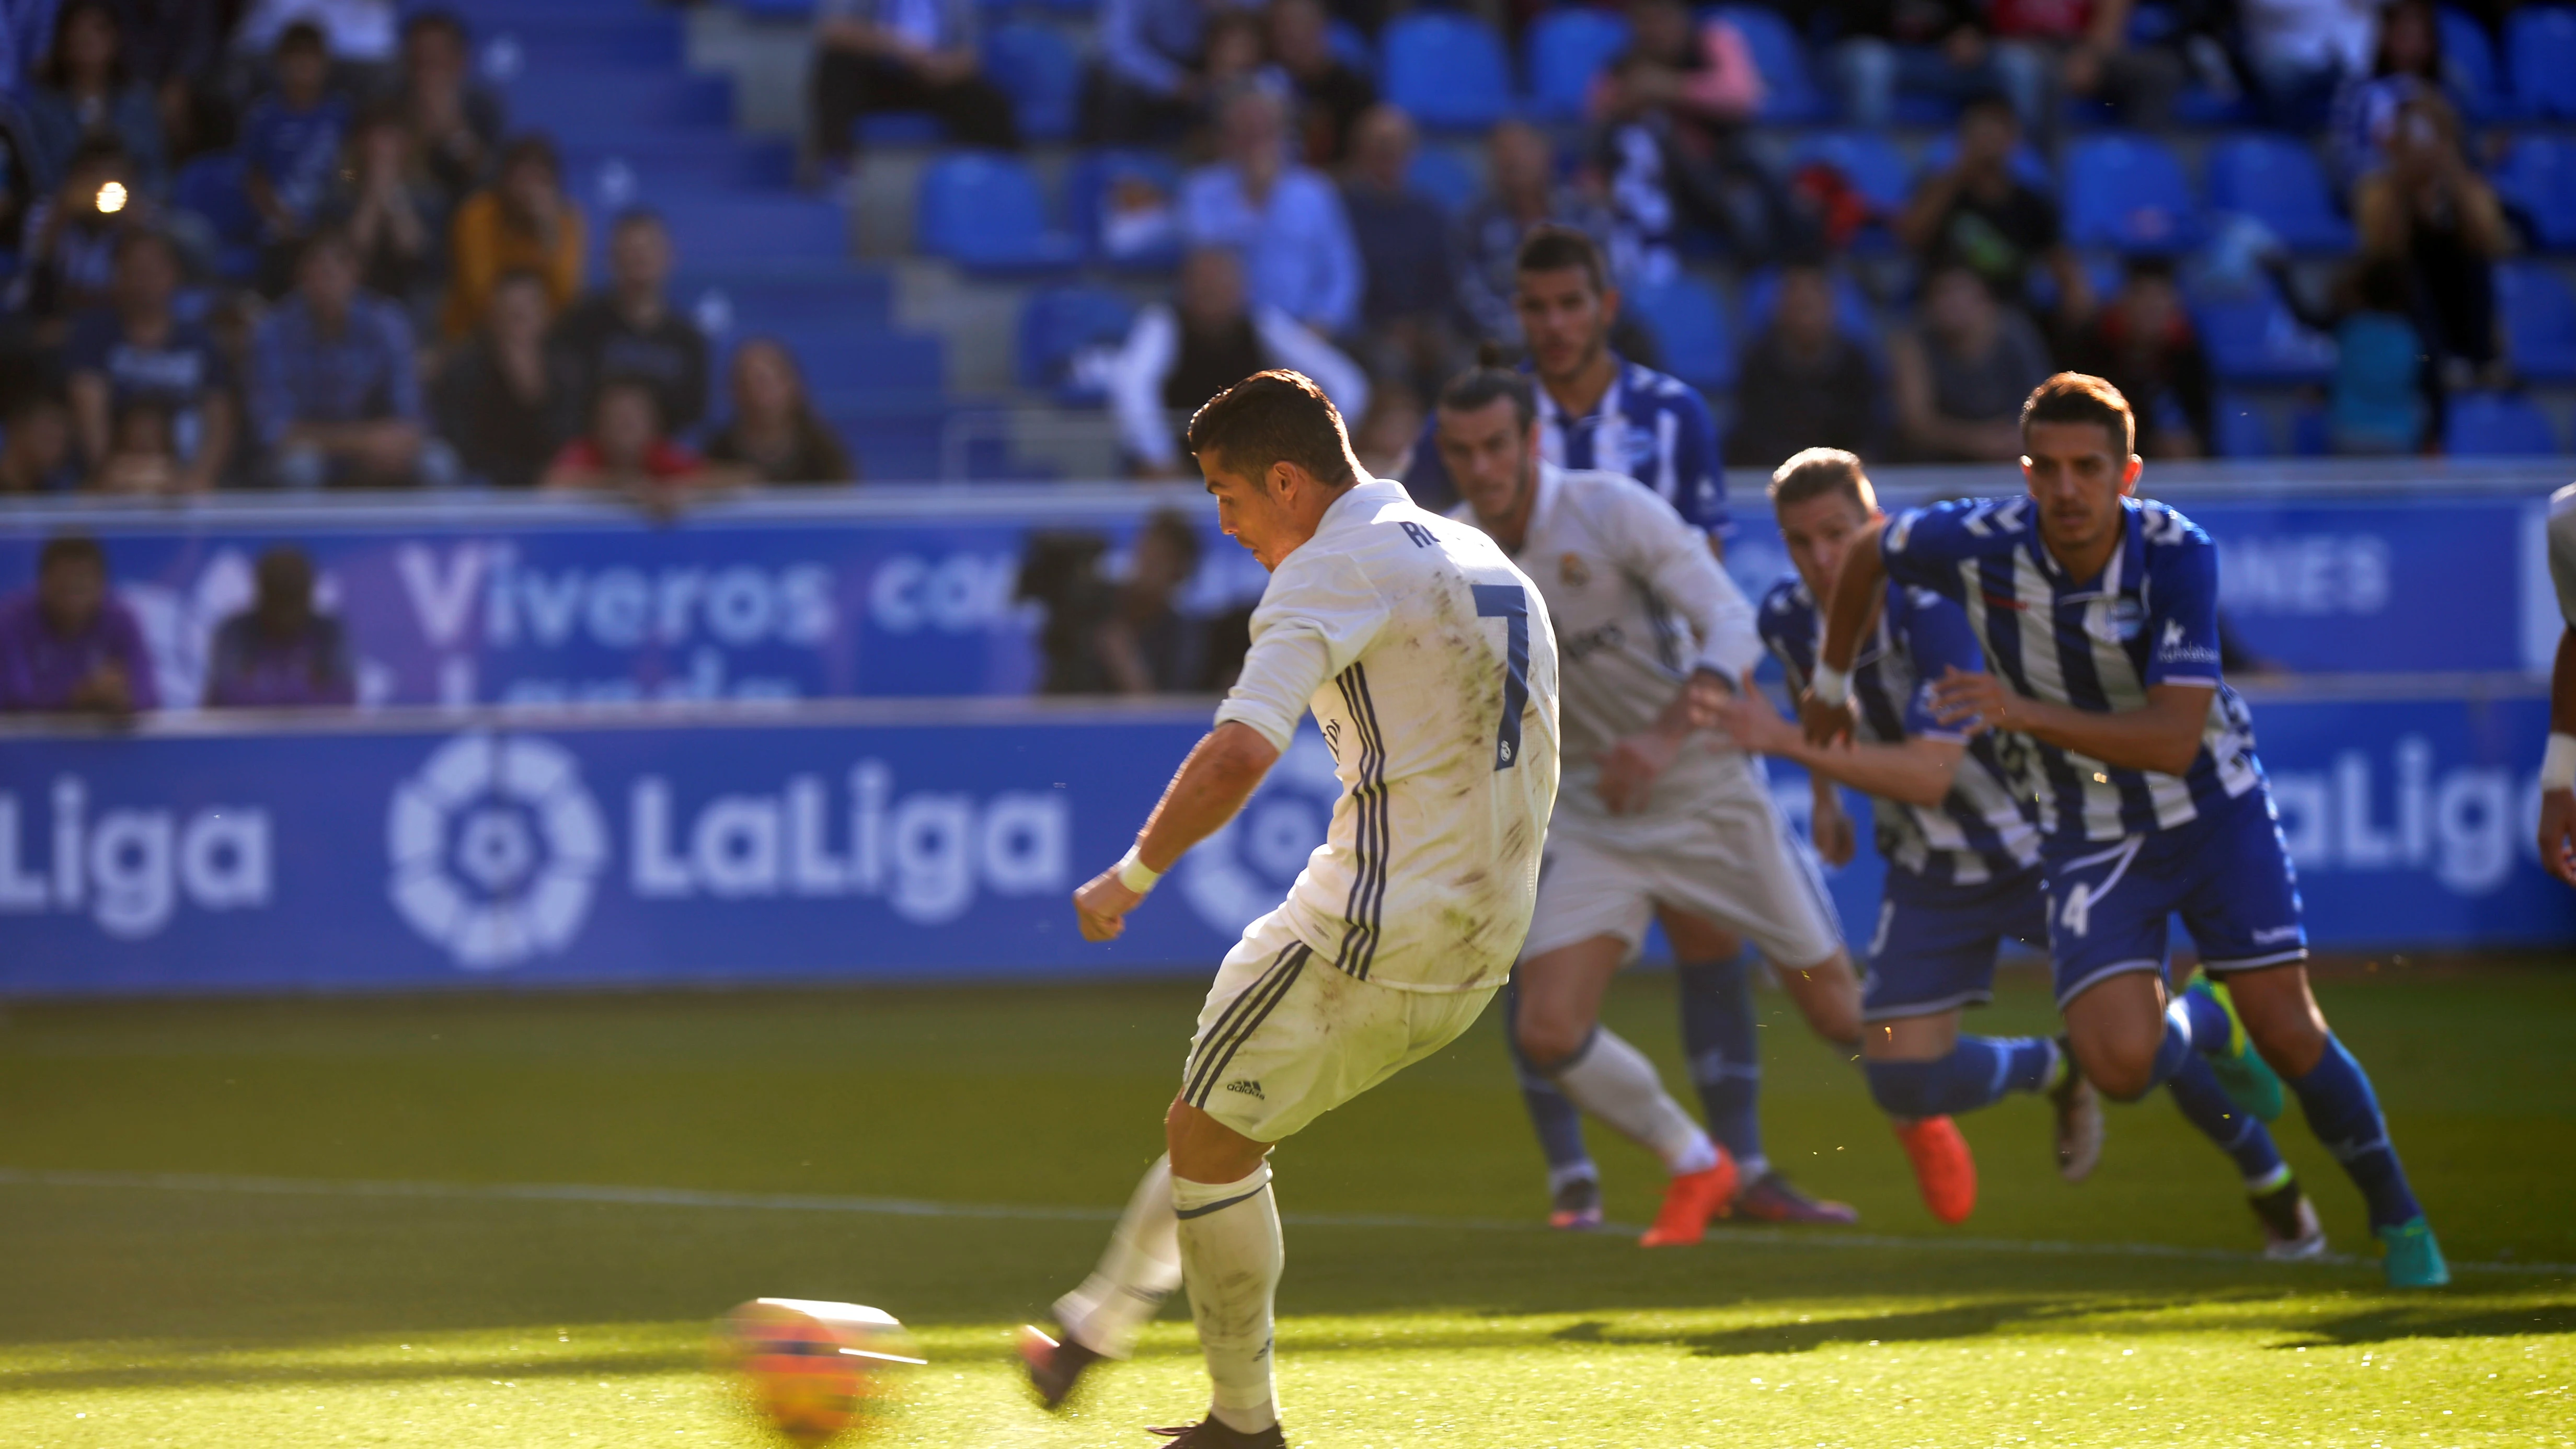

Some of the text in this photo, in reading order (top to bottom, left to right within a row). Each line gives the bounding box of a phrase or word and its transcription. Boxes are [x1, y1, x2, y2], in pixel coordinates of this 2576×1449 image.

[395, 538, 835, 648] Viveros
[1471, 584, 1530, 771] 7
[630, 757, 1070, 924] LaLiga
